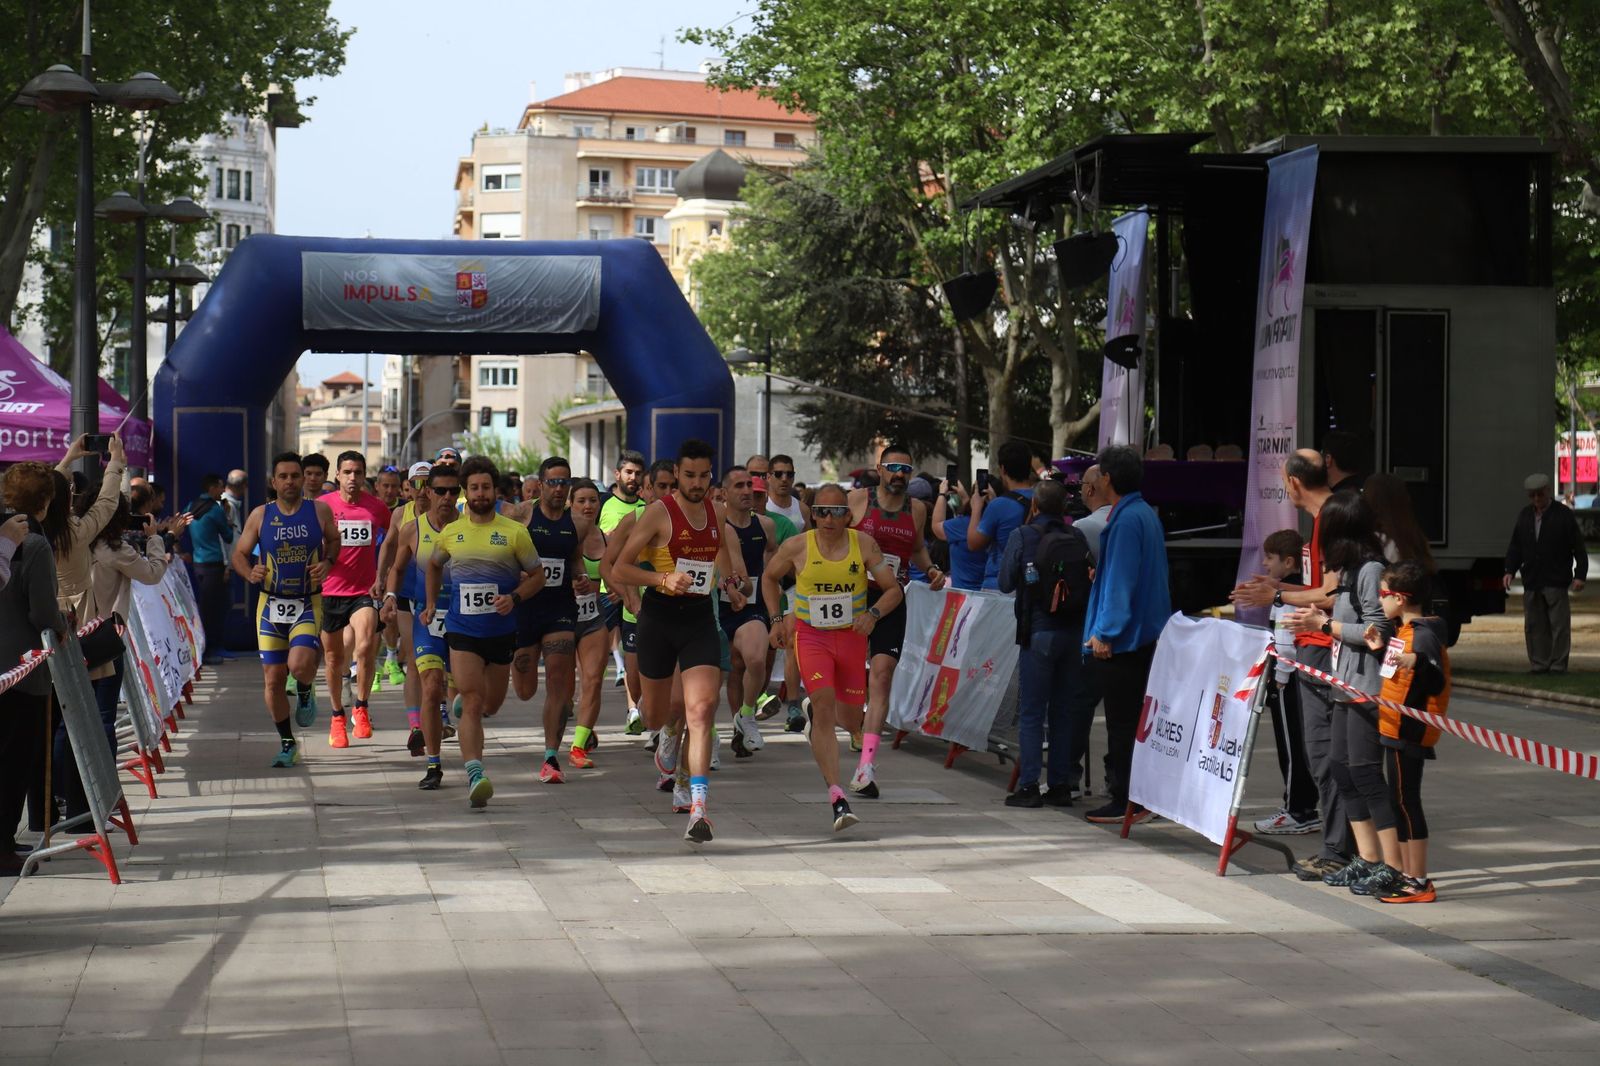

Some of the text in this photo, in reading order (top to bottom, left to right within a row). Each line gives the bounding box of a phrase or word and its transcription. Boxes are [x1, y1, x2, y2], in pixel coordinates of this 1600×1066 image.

[343, 270, 378, 283] NOS
[343, 284, 433, 303] IMPULSA
[492, 294, 563, 309] Junta de
[445, 310, 504, 324] Castilla
[274, 525, 308, 541] JESUS
[342, 527, 369, 540] 159
[277, 555, 307, 564] DUERO
[814, 583, 856, 593] TEAM
[463, 592, 496, 607] 156
[277, 603, 296, 617] 92
[819, 603, 843, 620] 18
